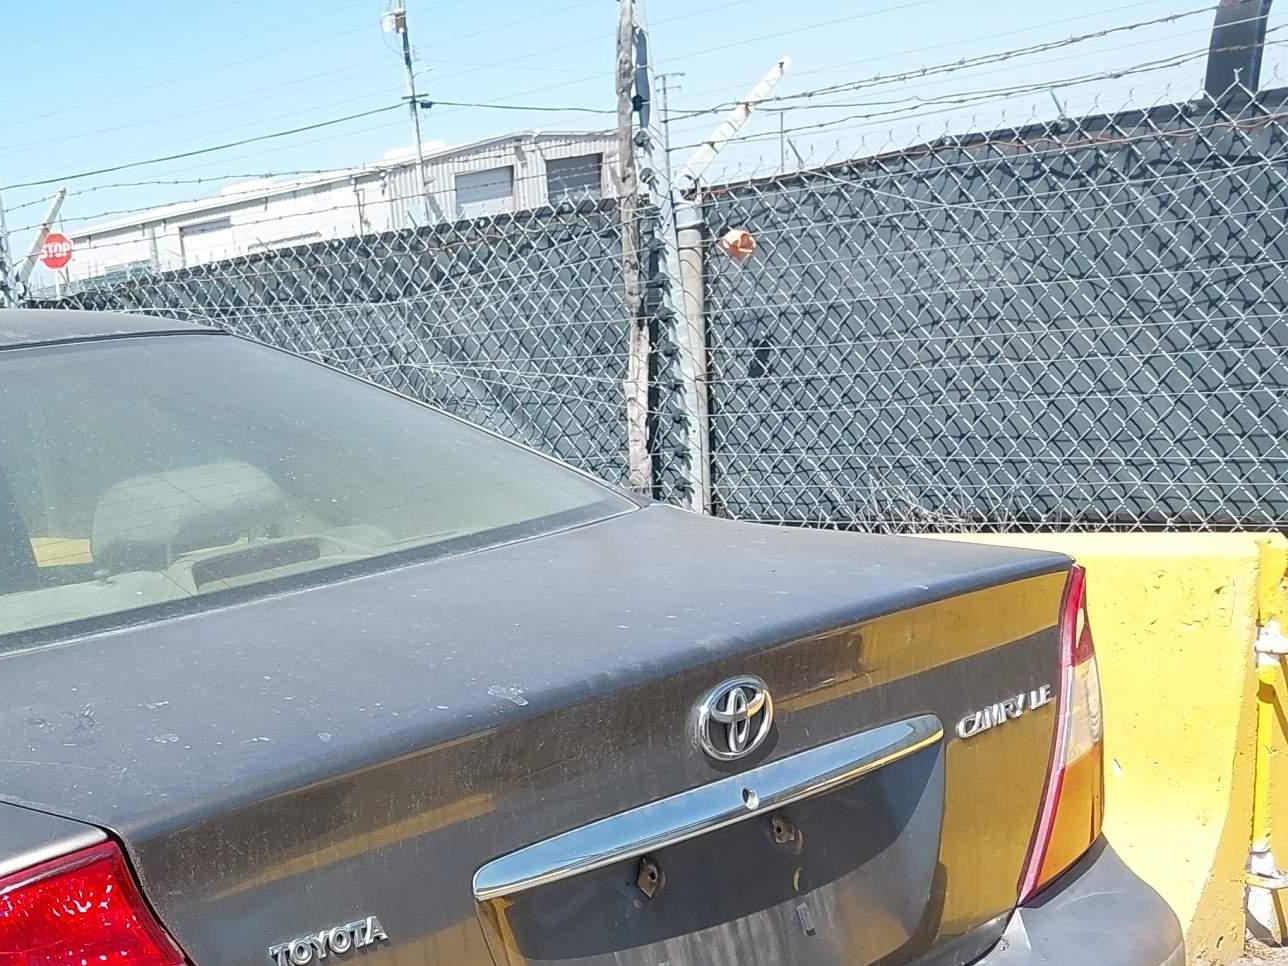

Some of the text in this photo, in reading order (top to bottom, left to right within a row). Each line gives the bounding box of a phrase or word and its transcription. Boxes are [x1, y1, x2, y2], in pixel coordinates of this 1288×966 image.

[40, 242, 70, 259] STOP
[957, 684, 1051, 739] CAMRY LE
